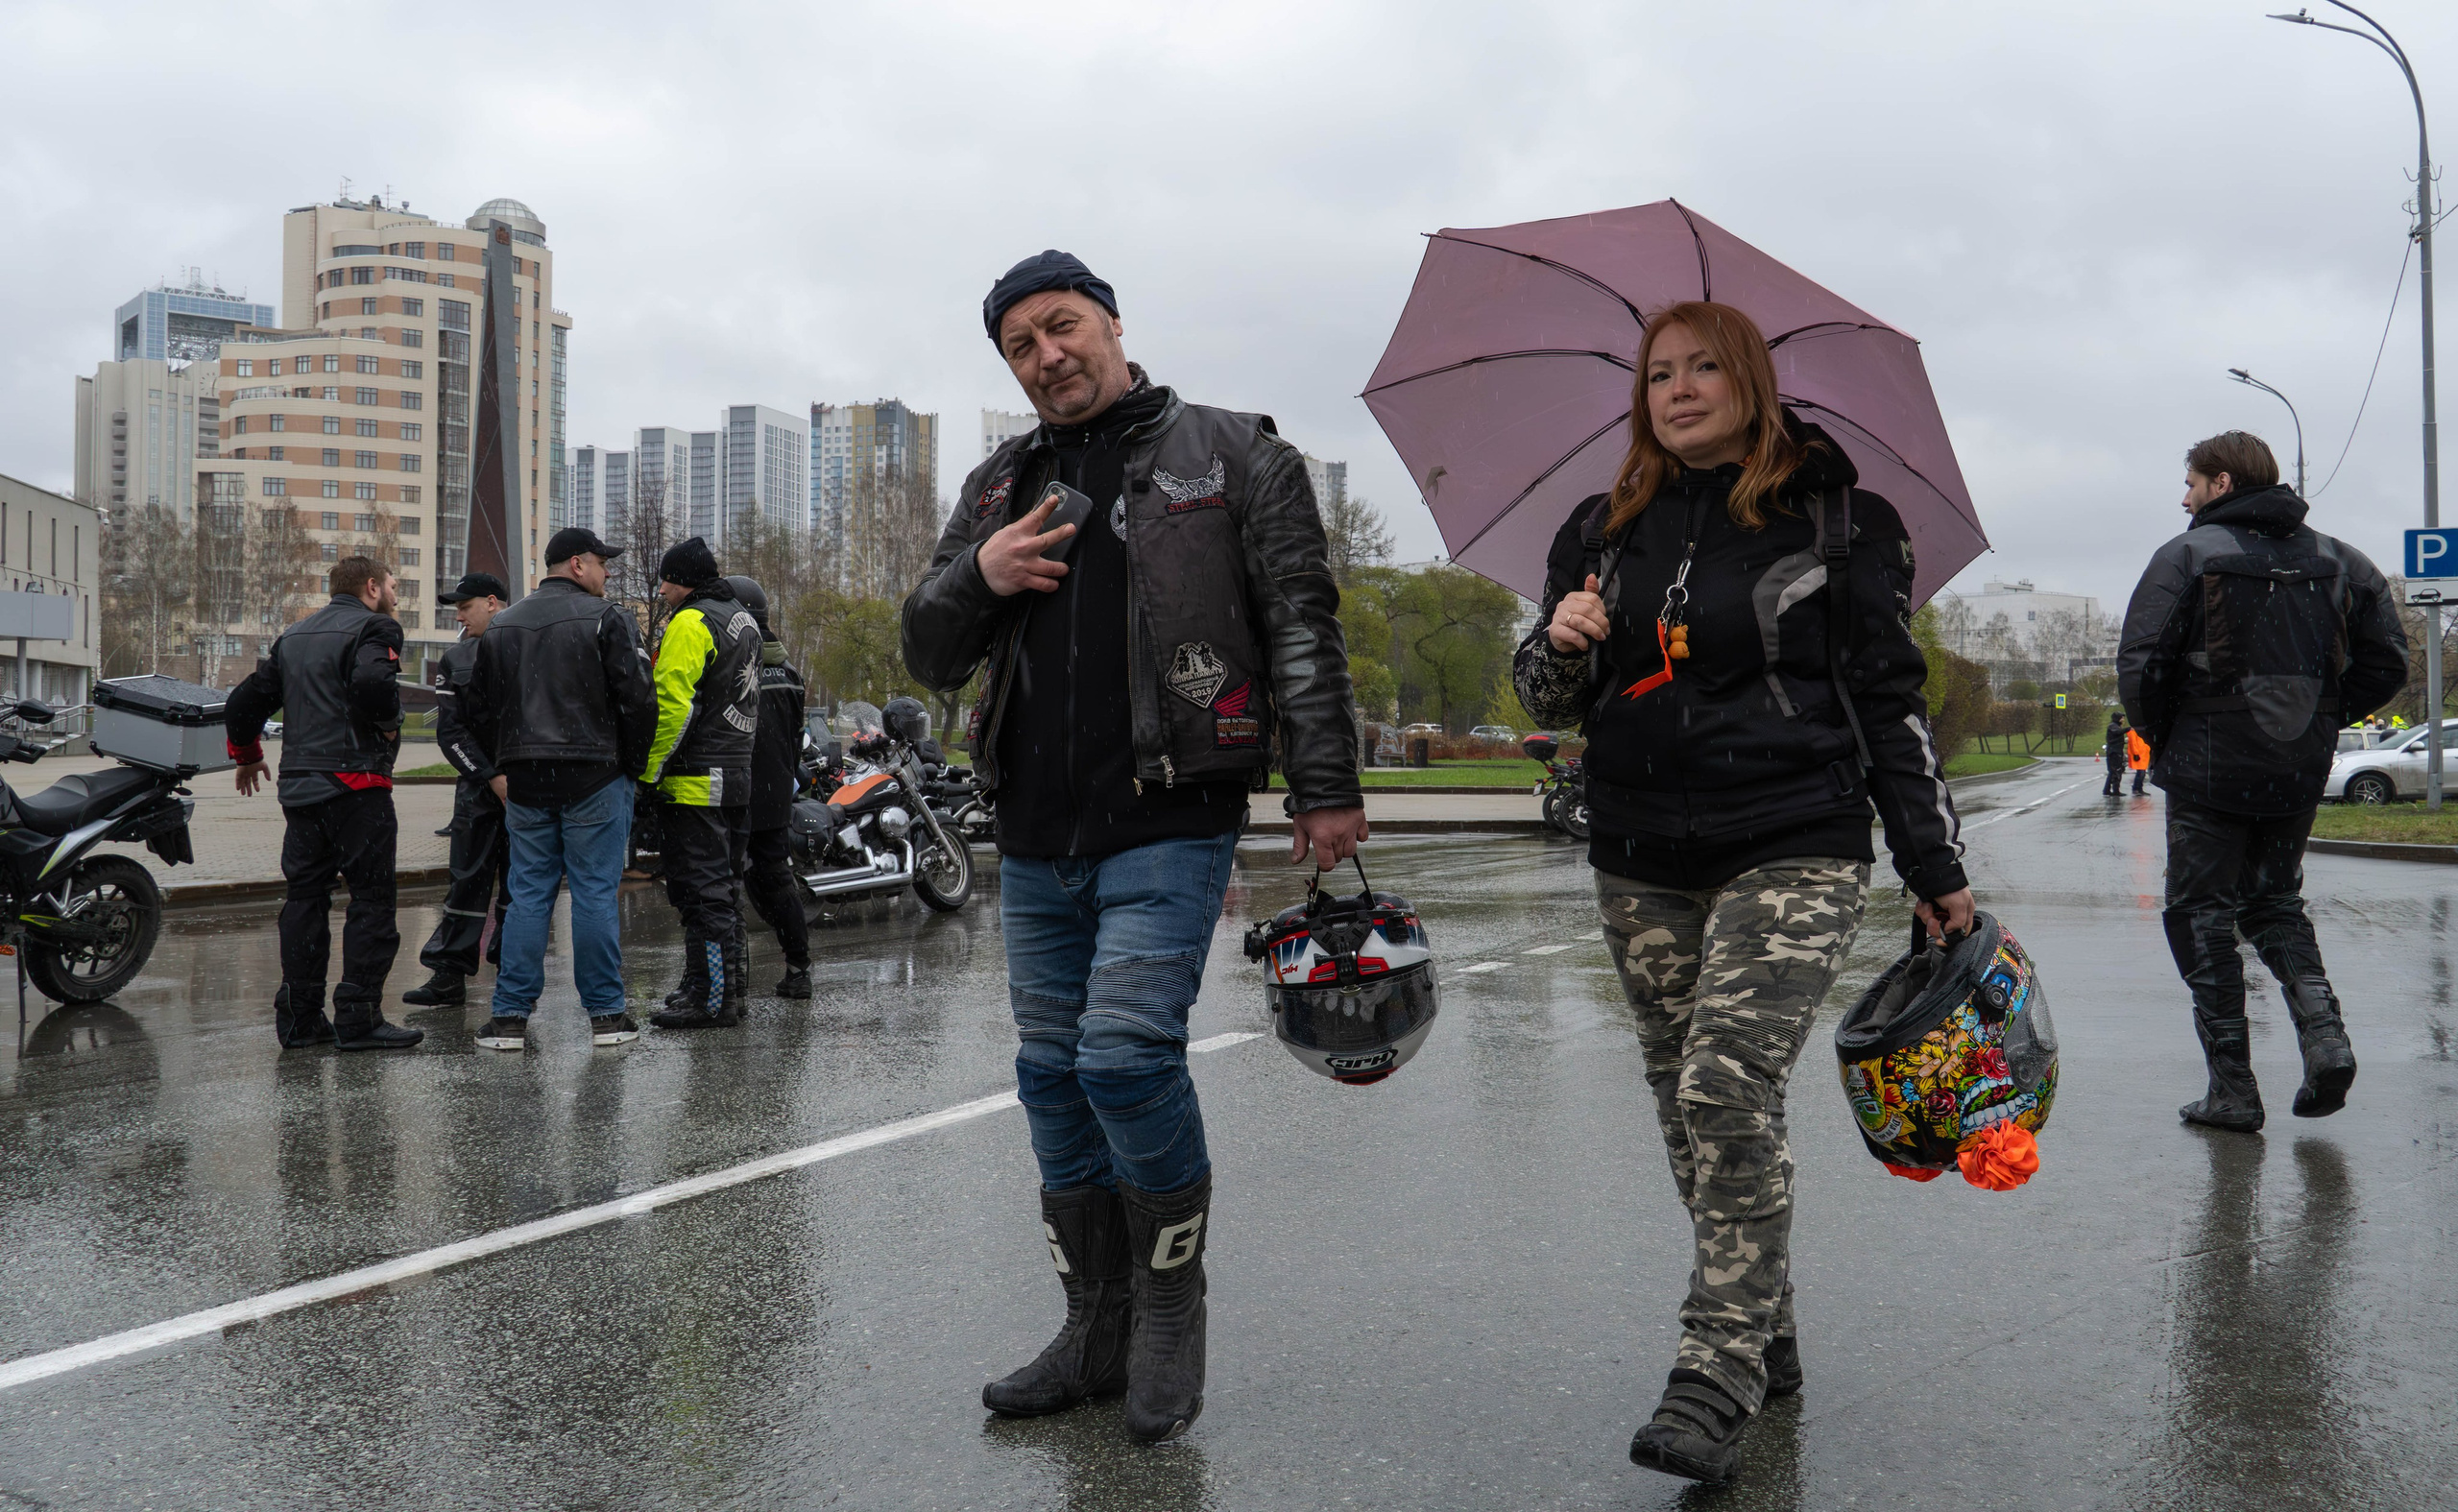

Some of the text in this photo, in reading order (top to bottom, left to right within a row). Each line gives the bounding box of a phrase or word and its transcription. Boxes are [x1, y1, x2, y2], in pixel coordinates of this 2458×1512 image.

[2417, 534, 2447, 573] P
[1192, 686, 1212, 698] 2019
[1217, 735, 1259, 745] HONDA
[1336, 1052, 1389, 1068] HJC
[1150, 1212, 1203, 1270] G
